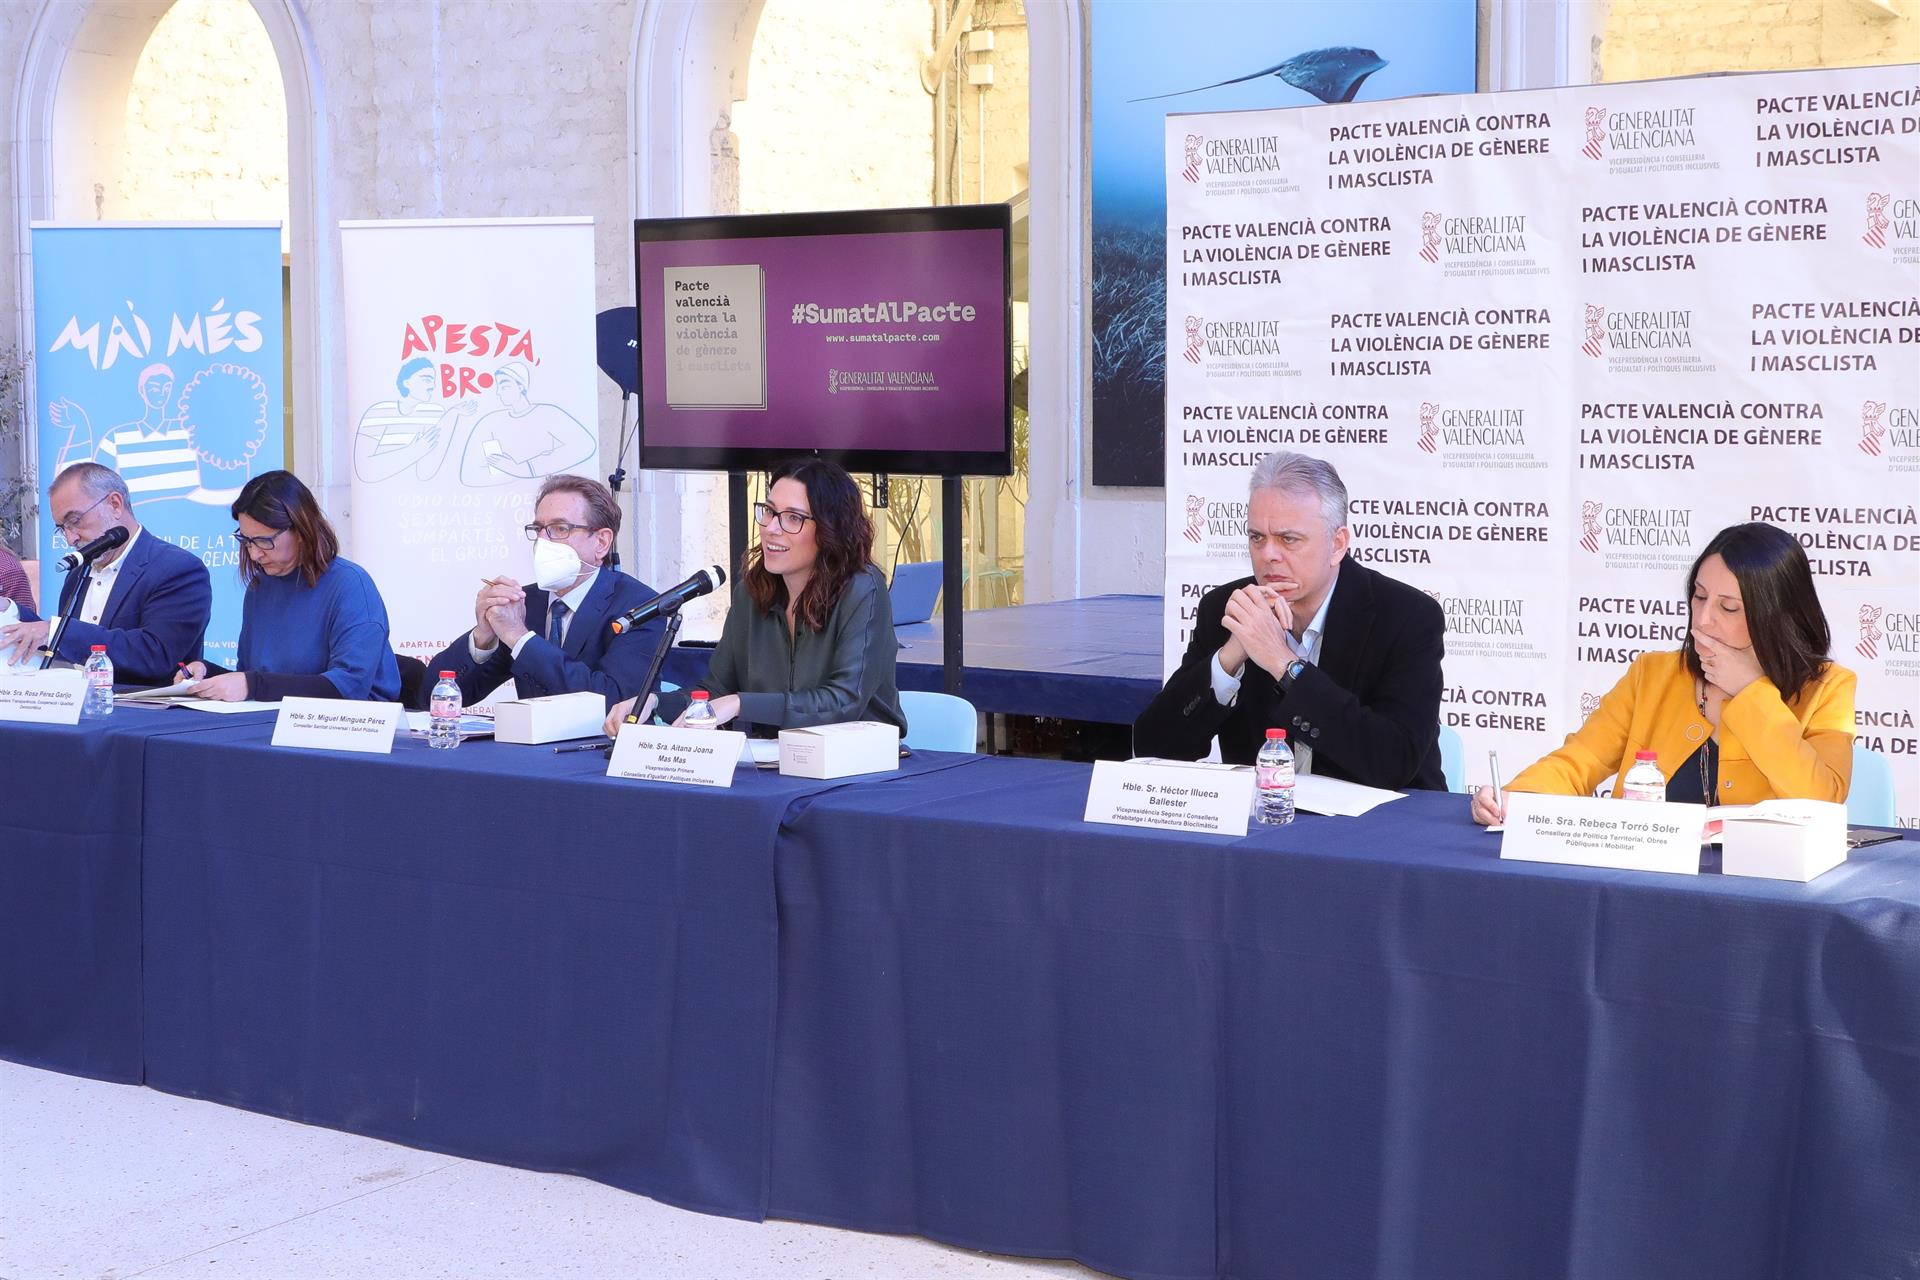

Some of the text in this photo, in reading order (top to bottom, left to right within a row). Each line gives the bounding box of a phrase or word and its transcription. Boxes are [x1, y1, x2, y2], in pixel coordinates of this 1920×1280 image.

[1756, 85, 1920, 115] PACTE VALENCIÀ
[1329, 112, 1551, 142] PACTE VALENCIÀ CONTRA
[1608, 108, 1696, 131] GENERALITAT
[1757, 116, 1920, 141] LA VIOLÈNCIA D
[1205, 136, 1278, 157] GENERALITAT
[1609, 128, 1695, 150] VALENCIANA
[1328, 137, 1550, 166] LA VIOLÈNCIA DE GÈNERE
[1767, 145, 1881, 167] MASCLISTA
[1206, 155, 1280, 174] VALENCIANA
[1338, 169, 1434, 189] MASCLISTA
[1582, 197, 1828, 223] PACTE VALENCIÀ CONTRA
[1182, 216, 1392, 240] PACTE VALENCIÀ CONTRA
[1445, 216, 1526, 236] GENERALITAT
[1582, 222, 1827, 249] LA VIOLÈNCIA DE GÈNERE
[1183, 239, 1391, 264] LA VIOLÈNCIA DE GÈNERE
[1445, 235, 1526, 254] VALENCIANA
[1592, 254, 1696, 273] MASCLISTA
[675, 281, 710, 291] Pacte
[1191, 269, 1282, 287] MASCLISTA
[676, 295, 731, 307] valencià
[1752, 296, 1920, 320] PACTE VALENCIÀ
[676, 312, 737, 323] contra la
[791, 301, 977, 324] #SumatAlPacte
[1331, 307, 1551, 329] PACTE VALENCIÀ CONTRA
[1607, 310, 1692, 330] GENERALITAT
[676, 328, 738, 339] violència
[826, 333, 940, 343] www.sumatalpacte.com
[1205, 321, 1279, 338] GENERALITAT
[1751, 329, 1777, 346] LA
[1781, 325, 1893, 345] VIOLÈNCIA
[1207, 339, 1280, 356] VALENCIANA
[1331, 331, 1550, 353] LA VIOLÈNCIA DE GÈNERE
[1608, 331, 1691, 349] VALENCIANA
[676, 344, 737, 358] de gènere
[1340, 360, 1432, 377] MASCLISTA
[1761, 354, 1877, 372] MASCLISTA
[839, 371, 935, 384] GENERALITAT VALENCIANA
[1183, 402, 1389, 421] PACTE VALENCIÀ CONTRA
[1442, 409, 1525, 427] GENERALITAT
[1581, 400, 1824, 420] PACTE VALENCIÀ CONTRA
[1183, 425, 1388, 444] LA VIOLÈNCIA DE GÈNERE
[1442, 428, 1525, 445] VALENCIANA
[1580, 425, 1822, 446] LA VIOLÈNCIA DE GÈNERE
[1589, 453, 1695, 470] MASCLISTA
[1382, 498, 1549, 518] VALENCIÀ CONTRA
[1750, 505, 1918, 525] PACTE VALENCIÀ
[1605, 509, 1693, 527] GENERALITAT
[1352, 521, 1548, 542] VIOLÈNCIA DE GÈNERE
[1606, 528, 1691, 546] VALENCIANA
[318, 714, 339, 722] Miguel
[638, 741, 714, 754] Hble. Sra. Aitana Joana
[658, 755, 686, 764] Mas Mas
[1122, 782, 1219, 799] Hble. Sr. Héctor Illueca
[1149, 796, 1187, 808] Ballester
[1161, 811, 1182, 819] Segona
[1186, 813, 1219, 821] Conselleria
[1527, 814, 1680, 834] Hble. Sra. Rebeca Torró Soler
[1535, 828, 1571, 838] Consellera
[1610, 834, 1645, 844] Territorial,
[1647, 837, 1668, 845] Obres
[1604, 842, 1635, 851] Mobilitat
